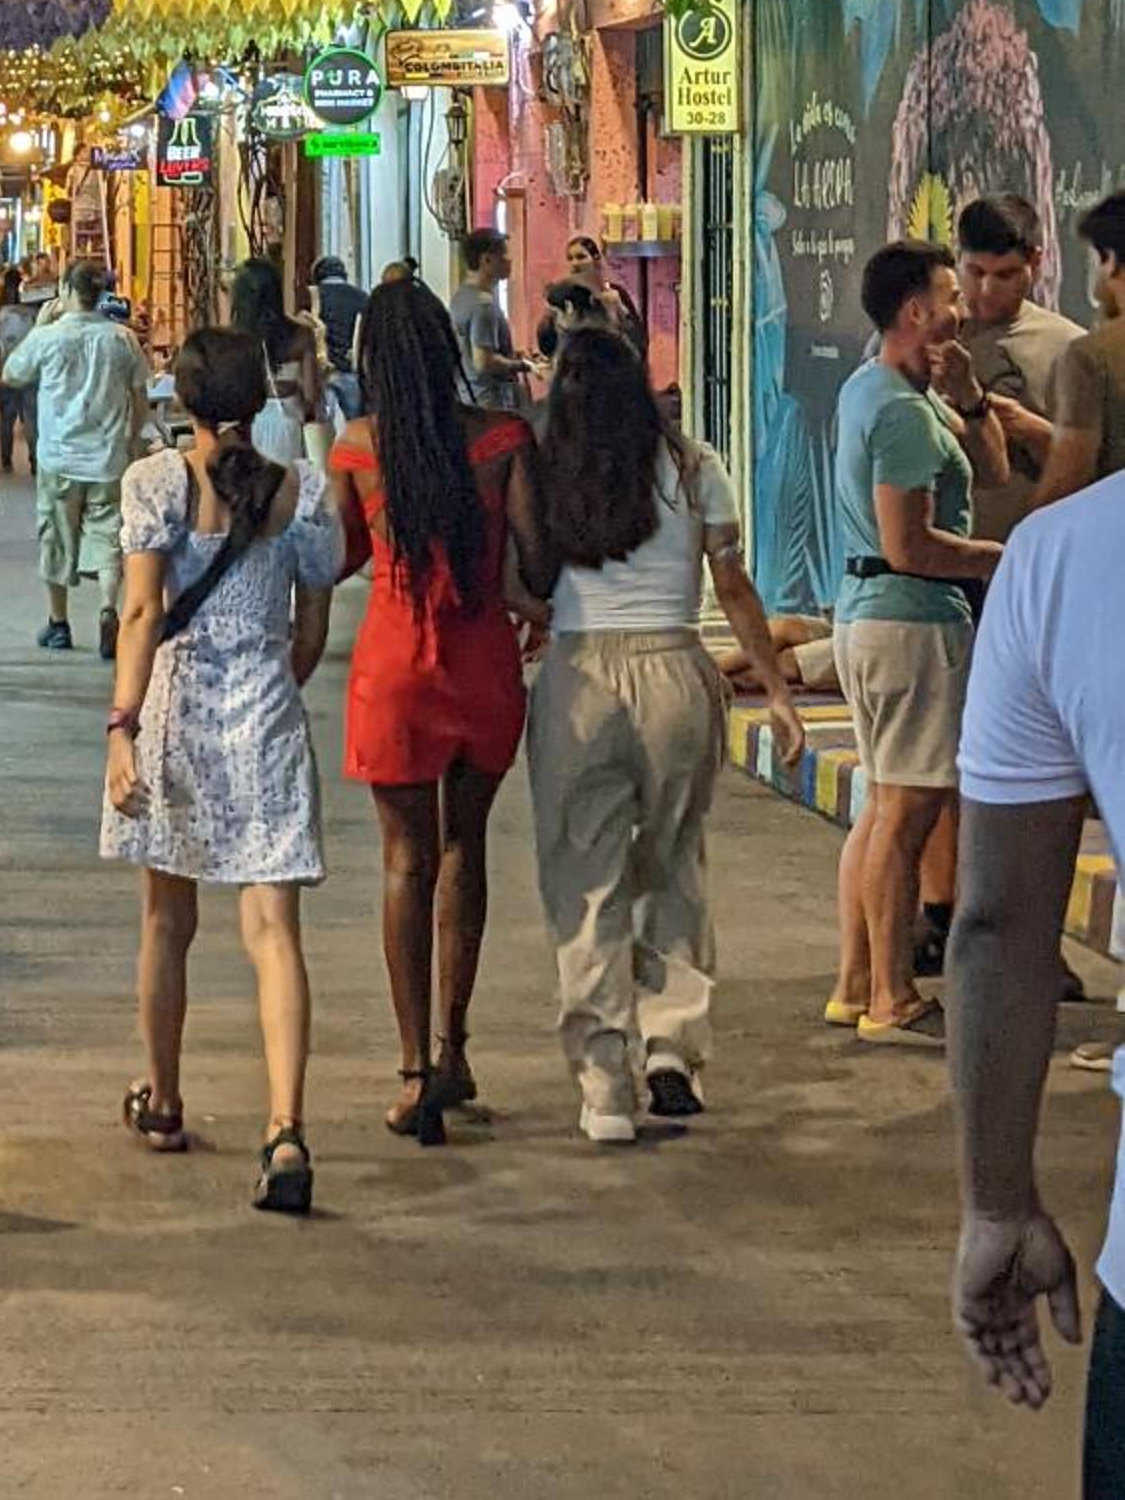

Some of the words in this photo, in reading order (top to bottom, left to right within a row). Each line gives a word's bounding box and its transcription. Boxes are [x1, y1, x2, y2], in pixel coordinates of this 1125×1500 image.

[403, 60, 504, 74] COLOMBITALIA
[678, 66, 731, 85] Artur
[311, 68, 380, 87] PURA
[677, 86, 732, 106] Hostel
[686, 111, 726, 125] 30-28
[166, 144, 201, 161] BEER
